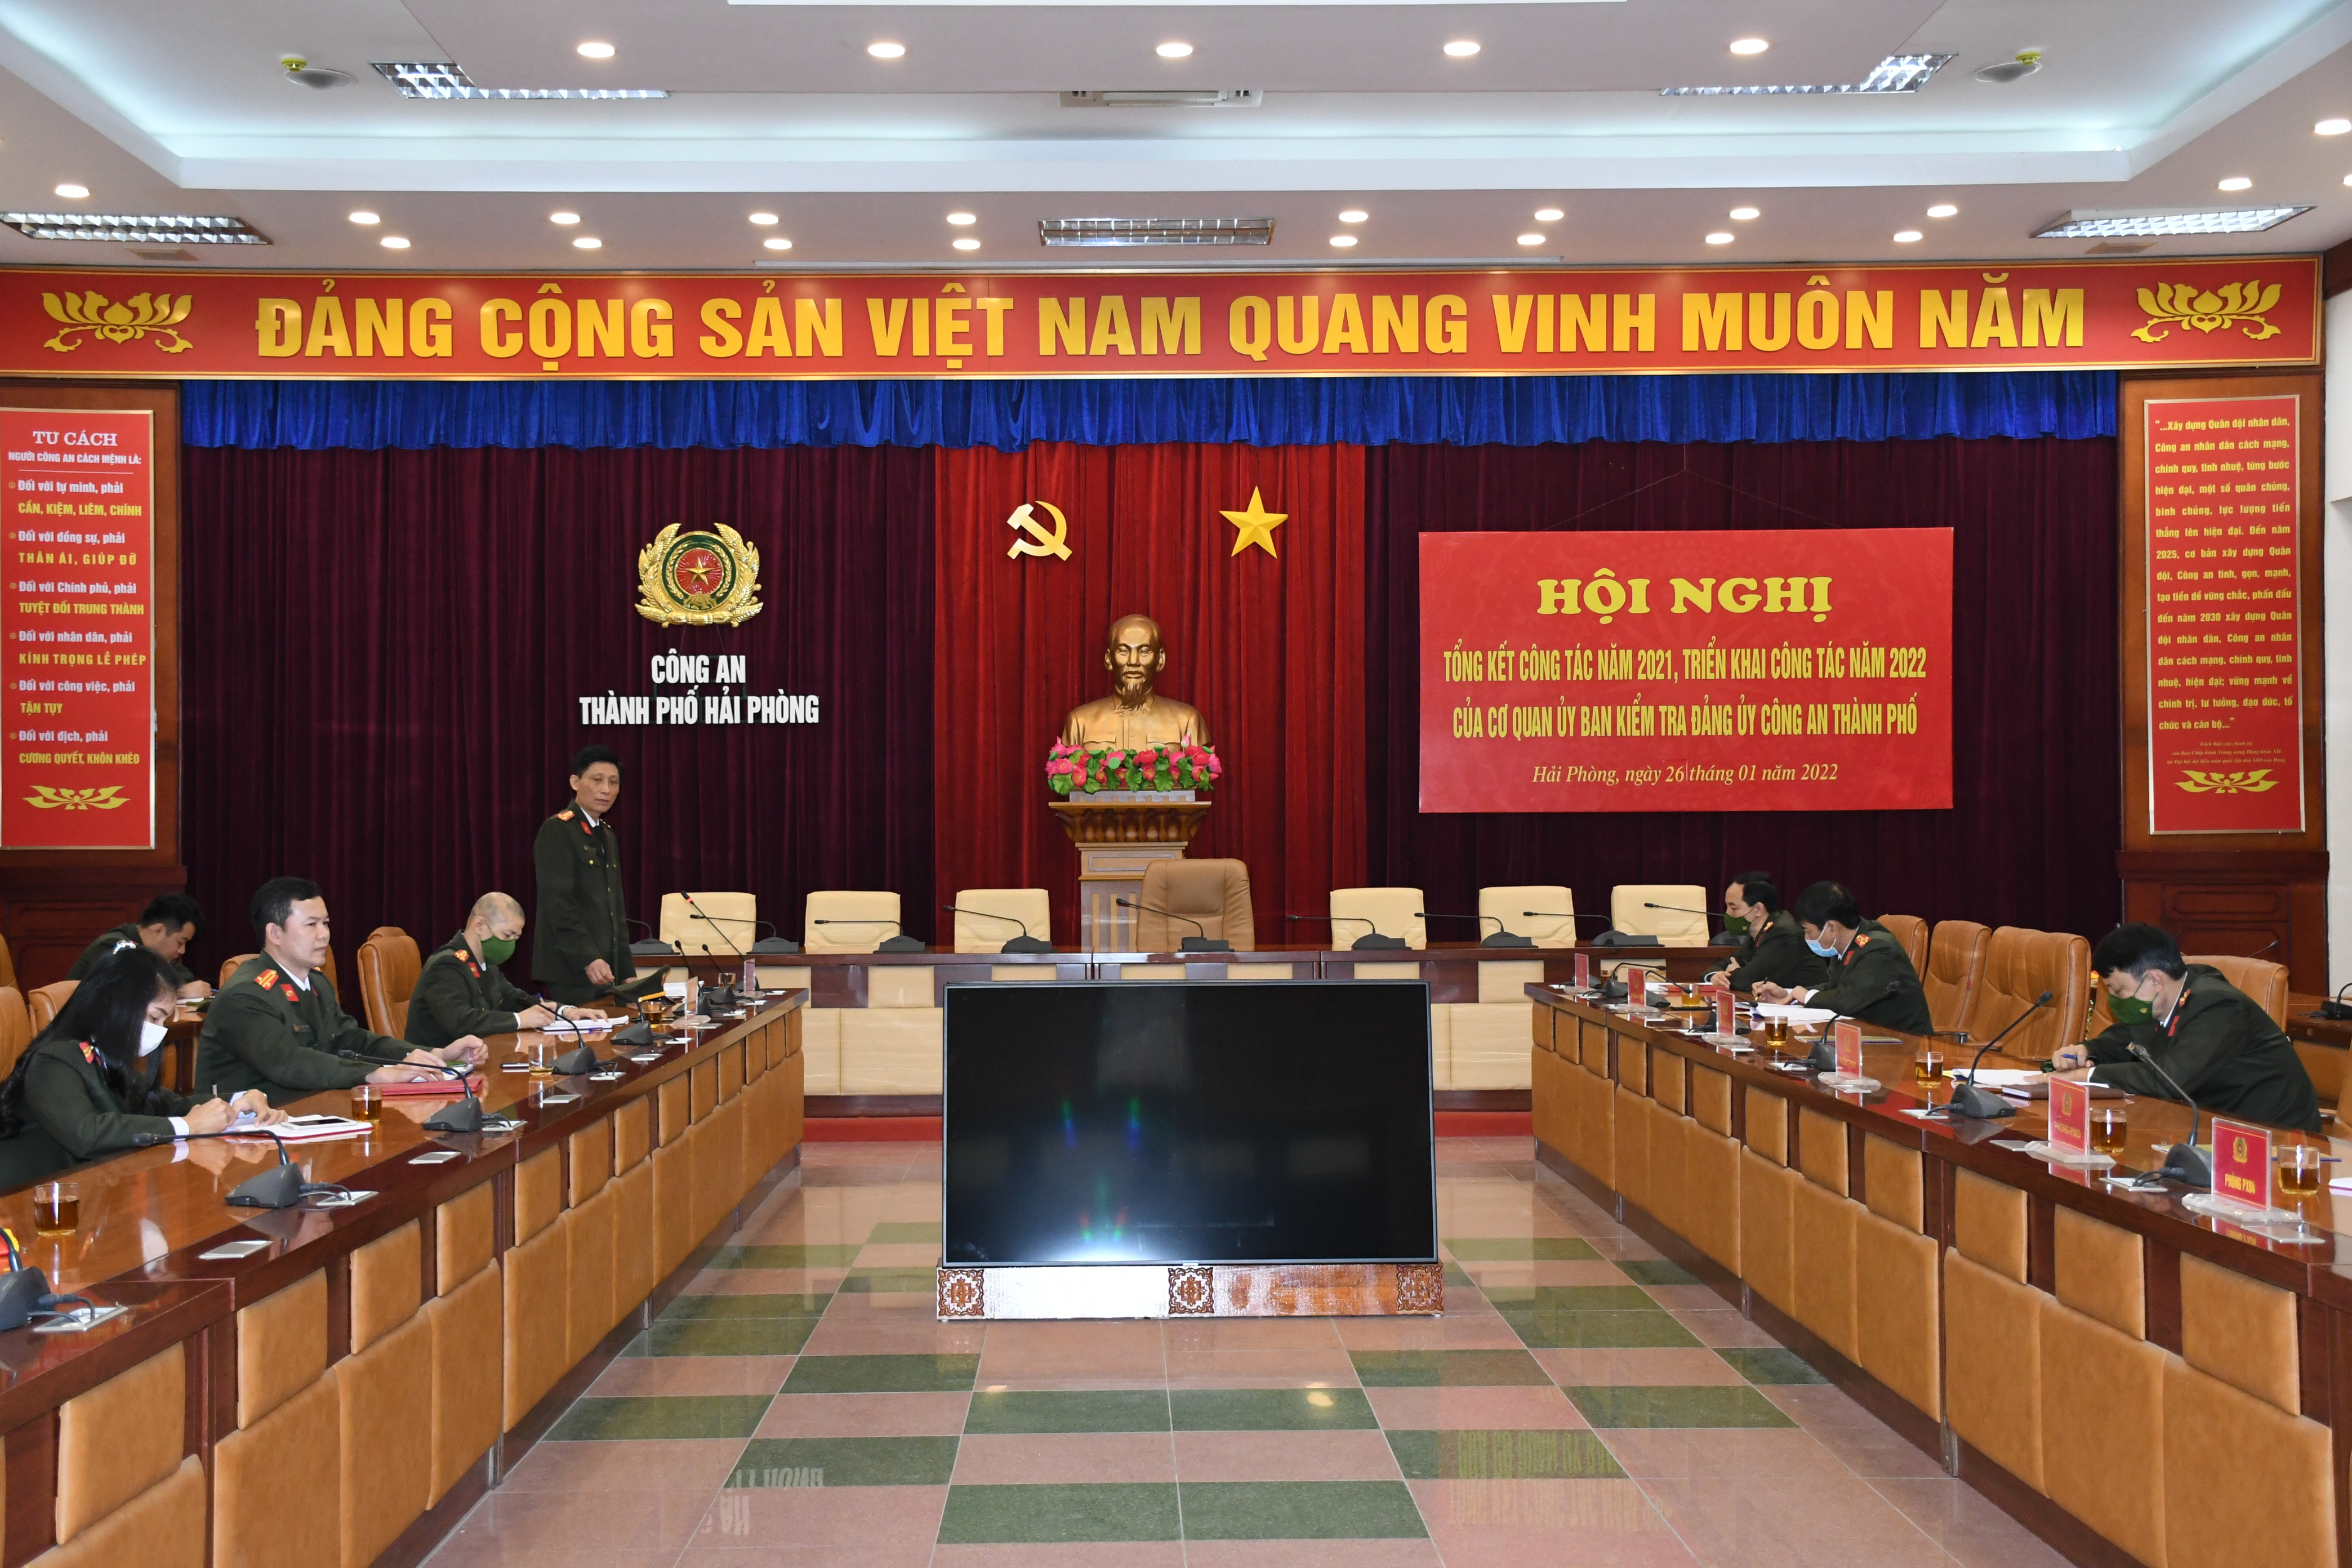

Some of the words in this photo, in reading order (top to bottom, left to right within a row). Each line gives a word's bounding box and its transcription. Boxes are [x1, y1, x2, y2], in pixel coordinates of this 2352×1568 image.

[255, 279, 454, 359] ĐẢNG
[480, 284, 674, 371] CỘNG
[700, 279, 843, 357] SẢN
[867, 283, 1013, 368] VIỆT
[1040, 296, 1201, 355] NAM
[1230, 293, 1467, 361] QUANG
[1493, 294, 1655, 353] VINH
[1682, 275, 1894, 351] MUÔN
[1920, 271, 2084, 348] NĂM
[2185, 421, 2206, 431] dựng
[2208, 420, 2230, 429] Quân
[2233, 419, 2245, 429] đội
[2248, 418, 2269, 427] nhân
[2271, 417, 2289, 426] dân,
[64, 430, 118, 446] CÁCH
[2155, 443, 2176, 452] Công
[2194, 442, 2215, 451] nhân
[2219, 441, 2234, 449] dân
[2239, 440, 2259, 449] cách
[2264, 440, 2289, 449] mạng,
[8, 451, 35, 461] NGƯỜI
[37, 452, 60, 462] CÔNG
[63, 454, 75, 462] AN
[77, 453, 100, 463] CÁCH
[102, 453, 127, 465] MỆNH
[18, 479, 35, 491] Đối
[38, 481, 54, 491] với
[56, 482, 67, 494] tự
[101, 482, 123, 494] phải
[110, 504, 141, 516] CHÍNH
[19, 530, 35, 541] Đối
[38, 532, 54, 542] với
[57, 531, 82, 544] đồng
[103, 532, 125, 544] phải
[19, 551, 54, 563] THÂN
[83, 553, 114, 564] GIÚP
[2157, 550, 2179, 559] 2025,
[2201, 548, 2216, 558] bản
[2222, 548, 2237, 558] xây
[2243, 548, 2264, 558] dựng
[2269, 546, 2291, 556] Quân
[19, 580, 35, 591] Đối
[39, 582, 54, 592] với
[57, 582, 87, 593] Chính
[114, 582, 136, 594] phải
[1537, 568, 1650, 624] HỘI
[1669, 577, 1832, 622] NGHỊ
[20, 601, 50, 615] TUYỆT
[53, 600, 70, 613] ĐỐI
[73, 604, 107, 614] TRUNG
[110, 602, 144, 614] THÀNH
[2158, 613, 2173, 623] đến
[2177, 613, 2195, 622] năm
[2200, 613, 2221, 622] 2030
[2226, 612, 2240, 621] xây
[2245, 612, 2265, 622] dựng
[2270, 611, 2292, 621] Quân
[19, 630, 35, 641] Đối
[39, 631, 54, 642] với
[57, 631, 82, 642] nhân
[110, 631, 132, 643] phải
[20, 652, 48, 664] KÍNH
[54, 654, 93, 666] TRỌNG
[97, 652, 110, 665] LỄ
[115, 653, 146, 665] PHÉP
[652, 648, 709, 683] CÔNG
[716, 655, 746, 683] AN
[1444, 639, 1482, 681] TỔNG
[1488, 640, 1514, 681] KẾT
[1520, 644, 1560, 681] CÔNG
[1565, 643, 1593, 680] TÁC
[1598, 643, 1632, 680] NĂM
[1638, 649, 1678, 683] 2021,
[1683, 636, 1726, 679] TRIỂN
[1731, 648, 1766, 679] KHAI
[1771, 642, 1811, 679] CÔNG
[1816, 641, 1845, 678] TÁC
[1850, 641, 1885, 678] NĂM
[1890, 647, 1926, 678] 2022
[19, 679, 36, 691] Đối
[39, 680, 54, 691] với
[58, 681, 82, 692] công
[113, 680, 135, 693] phải
[2158, 678, 2181, 688] nhuệ,
[2186, 678, 2204, 688] hiện
[2255, 676, 2277, 686] mạnh
[20, 701, 41, 715] TẬN
[44, 703, 63, 715] TỤY
[580, 691, 649, 724] THÀNH
[656, 686, 698, 724] PHỐ
[705, 686, 740, 724] HẢI
[747, 689, 819, 723] PHÒNG
[1453, 697, 1483, 738] CỦA
[1488, 703, 1508, 738] CƠ
[1513, 707, 1552, 741] QUAN
[1557, 696, 1576, 737] ỦY
[1581, 706, 1611, 736] BAN
[1617, 693, 1654, 736] KIỂM
[1659, 706, 1686, 736] TRA
[1691, 694, 1732, 736] ĐẢNG
[1738, 694, 1756, 736] ỦY
[1761, 698, 1802, 735] CÔNG
[1807, 704, 1828, 734] AN
[1833, 697, 1882, 734] THÀNH
[1887, 692, 1917, 734] PHỐ
[2159, 721, 2179, 729] chức
[2182, 720, 2191, 729] và
[2194, 720, 2209, 729] cán
[19, 729, 36, 741] Đối
[39, 731, 54, 741] với
[86, 730, 108, 742] phải
[87, 752, 113, 764] KHÔN
[115, 752, 140, 764] KHÉO
[1533, 765, 1561, 782] Hải
[1566, 766, 1619, 786] Phòng,
[1625, 765, 1661, 786] ngày
[1665, 764, 1685, 782] 26
[1690, 765, 1734, 785] tháng
[1739, 765, 1756, 781] 01
[1762, 765, 1795, 780] năm
[1801, 764, 1837, 780] 2022
[2225, 1172, 2242, 1191] PHÒNG
[2242, 1178, 2256, 1195] PX04
